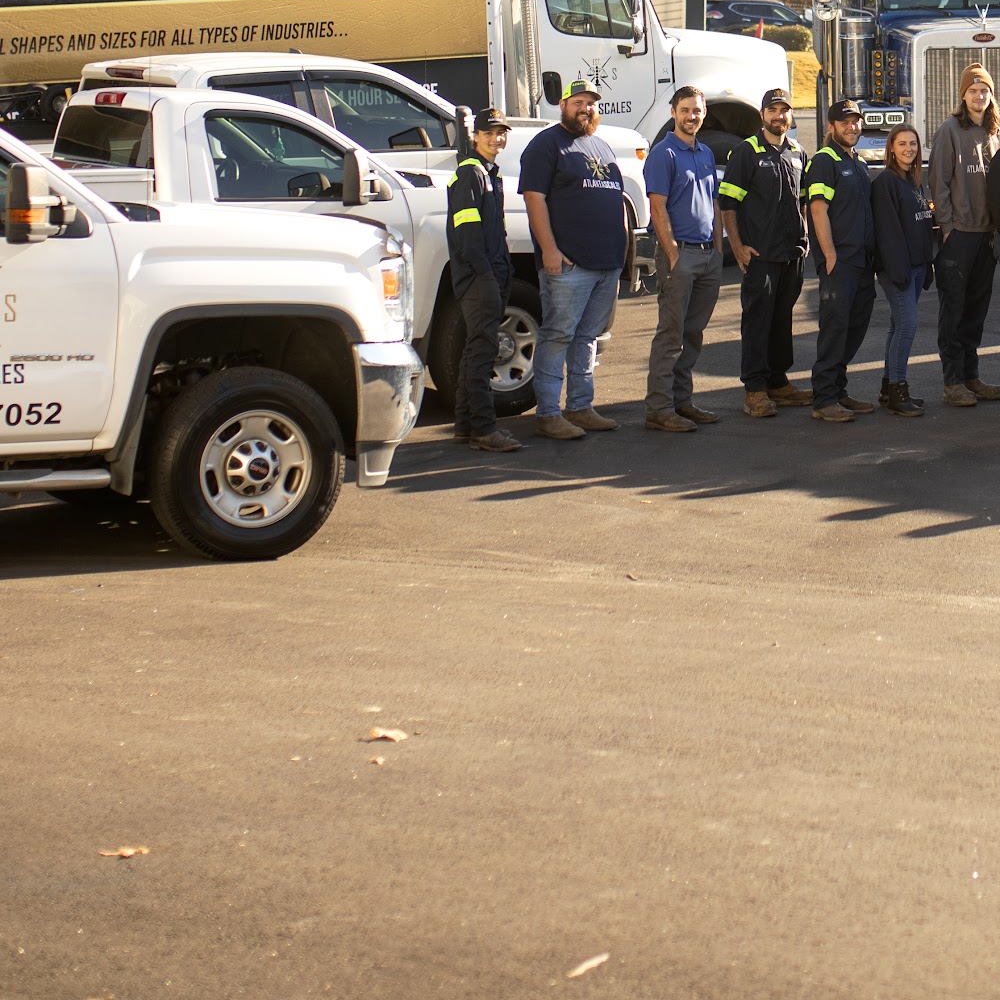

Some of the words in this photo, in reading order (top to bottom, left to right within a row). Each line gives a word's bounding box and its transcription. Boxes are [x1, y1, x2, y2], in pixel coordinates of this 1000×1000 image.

[10, 35, 64, 55] SHAPES
[67, 33, 96, 51] AND
[100, 31, 137, 49] SIZES
[140, 30, 166, 47] FOR
[171, 29, 195, 46] ALL
[199, 26, 238, 44] TYPES
[241, 25, 259, 42] OF
[347, 88, 382, 107] HOUR
[4, 294, 17, 322] S
[0, 363, 25, 385] ES
[0, 402, 63, 427] 052
